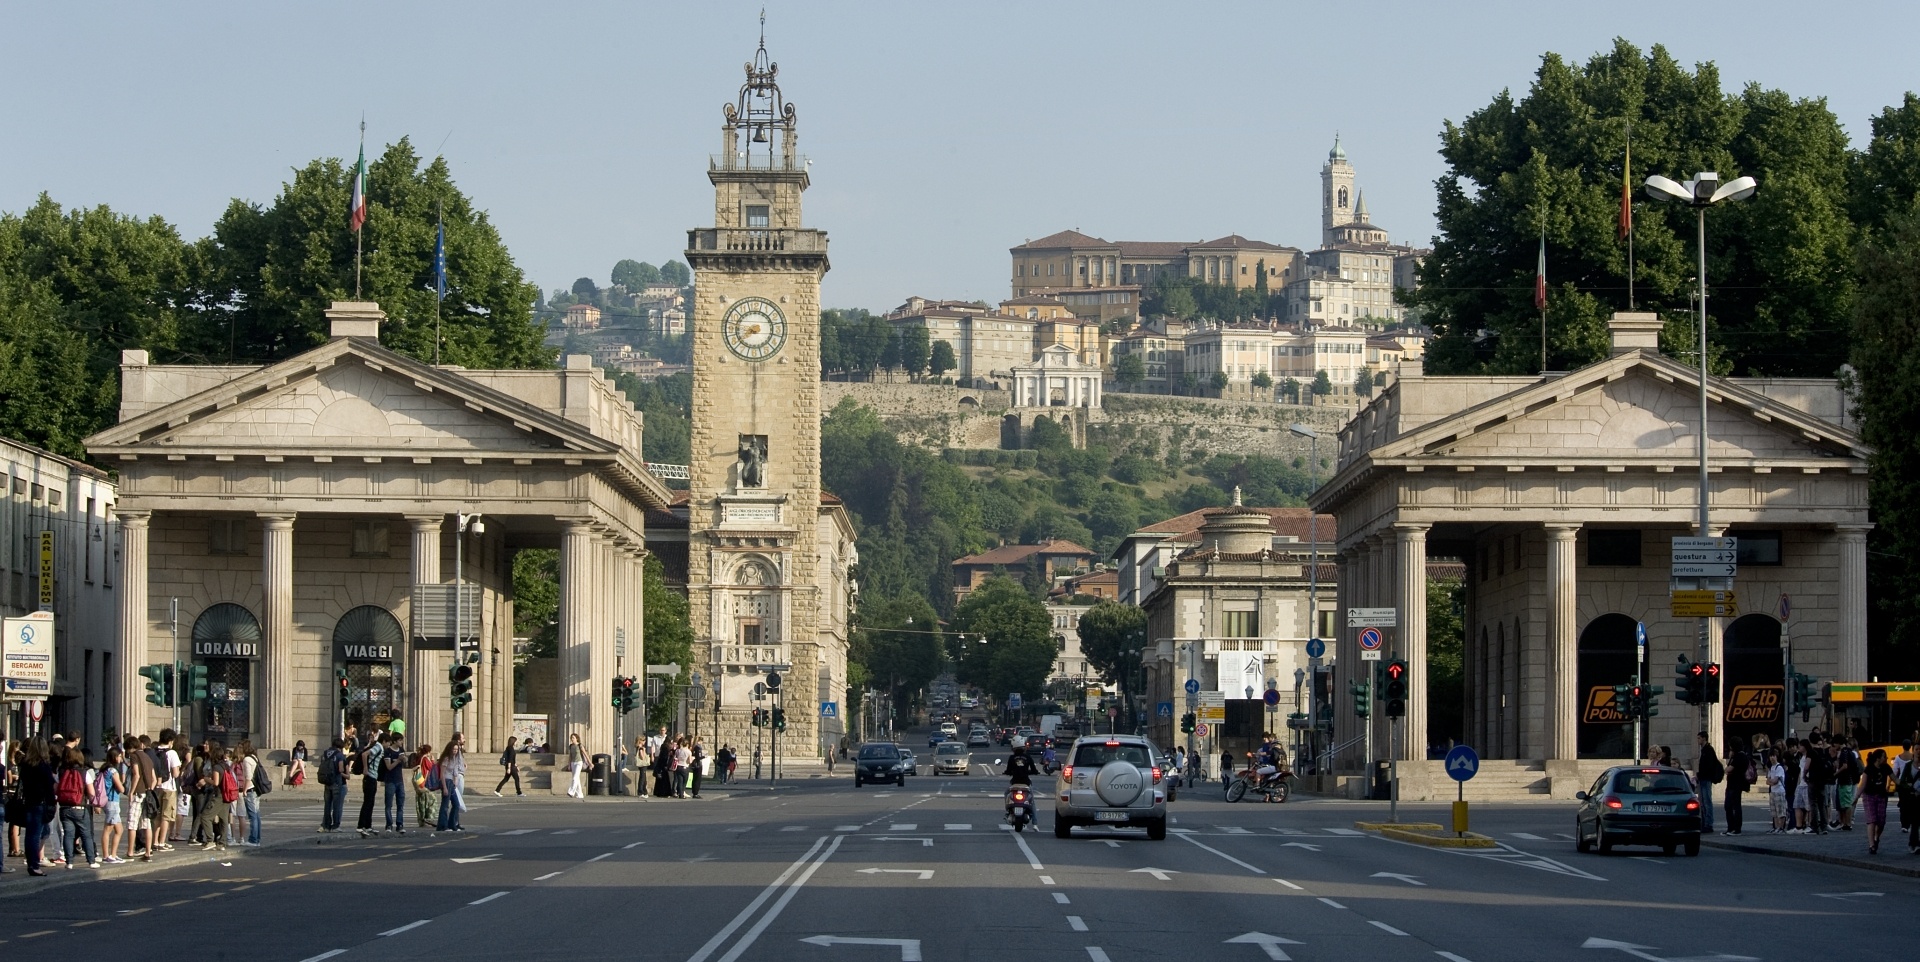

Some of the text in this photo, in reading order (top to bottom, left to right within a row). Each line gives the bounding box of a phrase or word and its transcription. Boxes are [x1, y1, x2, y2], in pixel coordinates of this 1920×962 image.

[750, 302, 760, 310] 12
[42, 533, 51, 551] BAR
[1674, 553, 1707, 561] questura
[1673, 566, 1704, 574] prefettura
[41, 559, 51, 603] TURISMO
[195, 642, 258, 656] LORANDI
[344, 645, 393, 658] VIAGGI
[11, 662, 44, 670] BERGAMO
[1731, 707, 1775, 719] POINT
